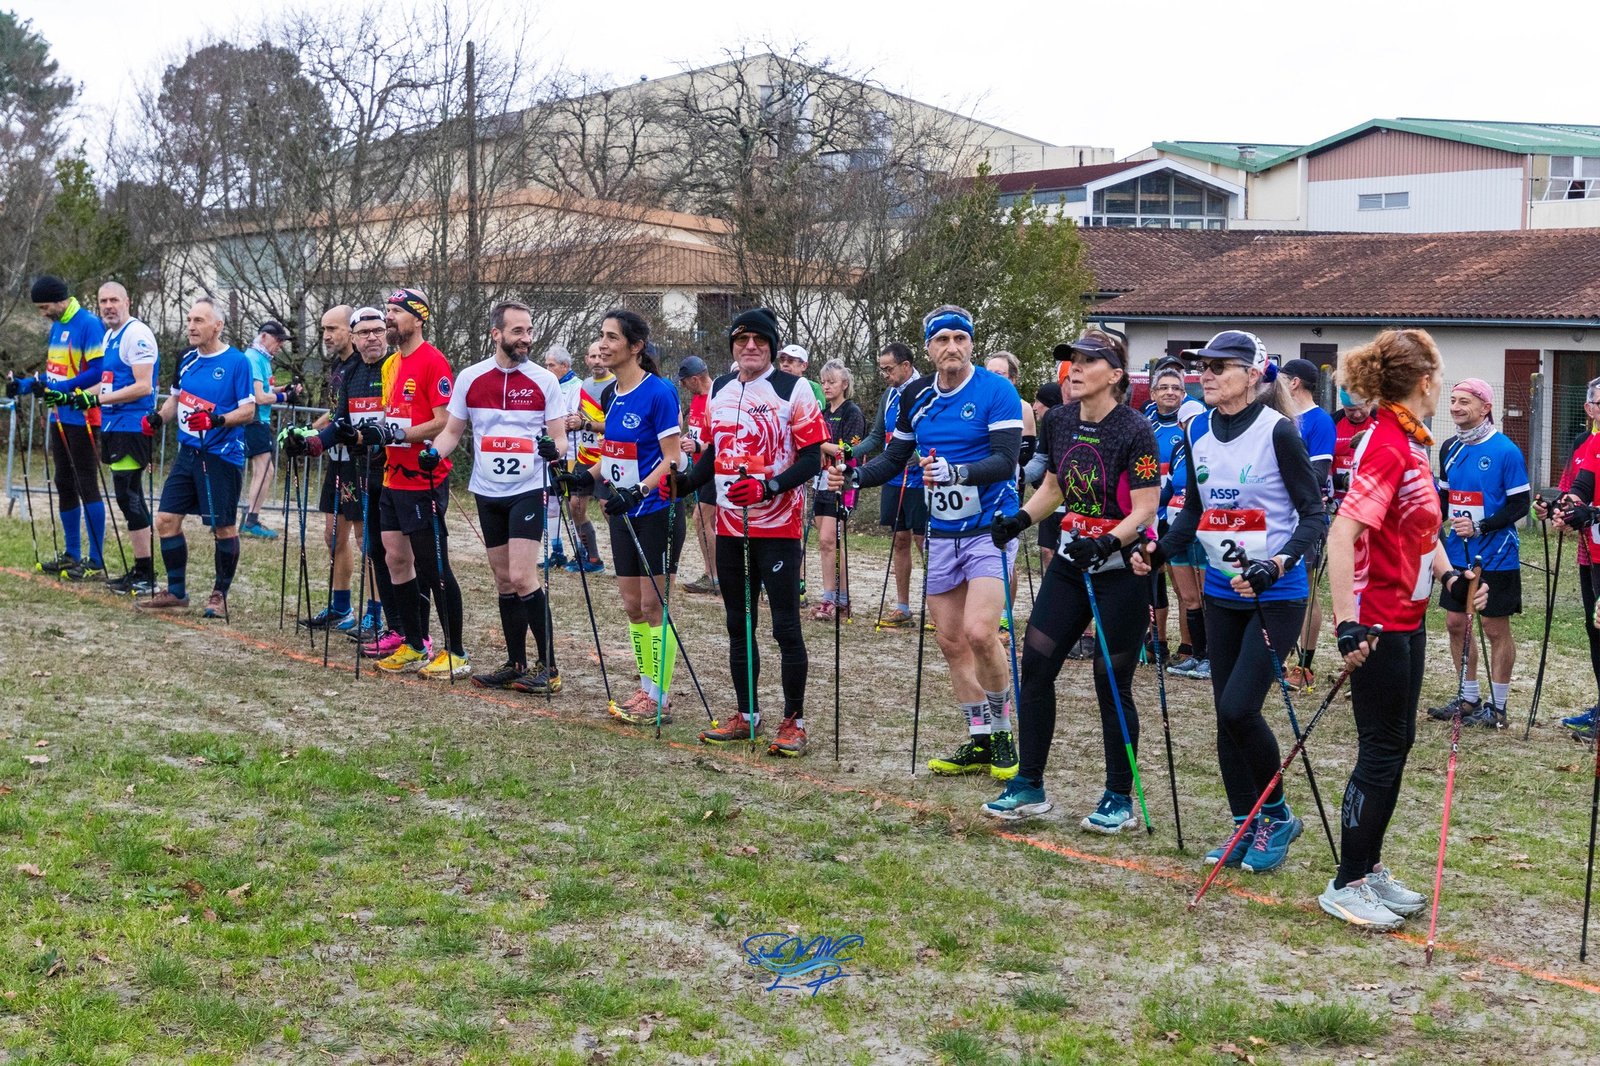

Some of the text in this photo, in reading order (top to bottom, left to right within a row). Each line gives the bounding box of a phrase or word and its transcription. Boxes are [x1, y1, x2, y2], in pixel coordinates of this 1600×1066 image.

[582, 432, 594, 444] 64
[492, 457, 521, 475] 32
[611, 463, 621, 482] 6
[934, 490, 963, 511] 30
[1210, 487, 1241, 500] ASSP
